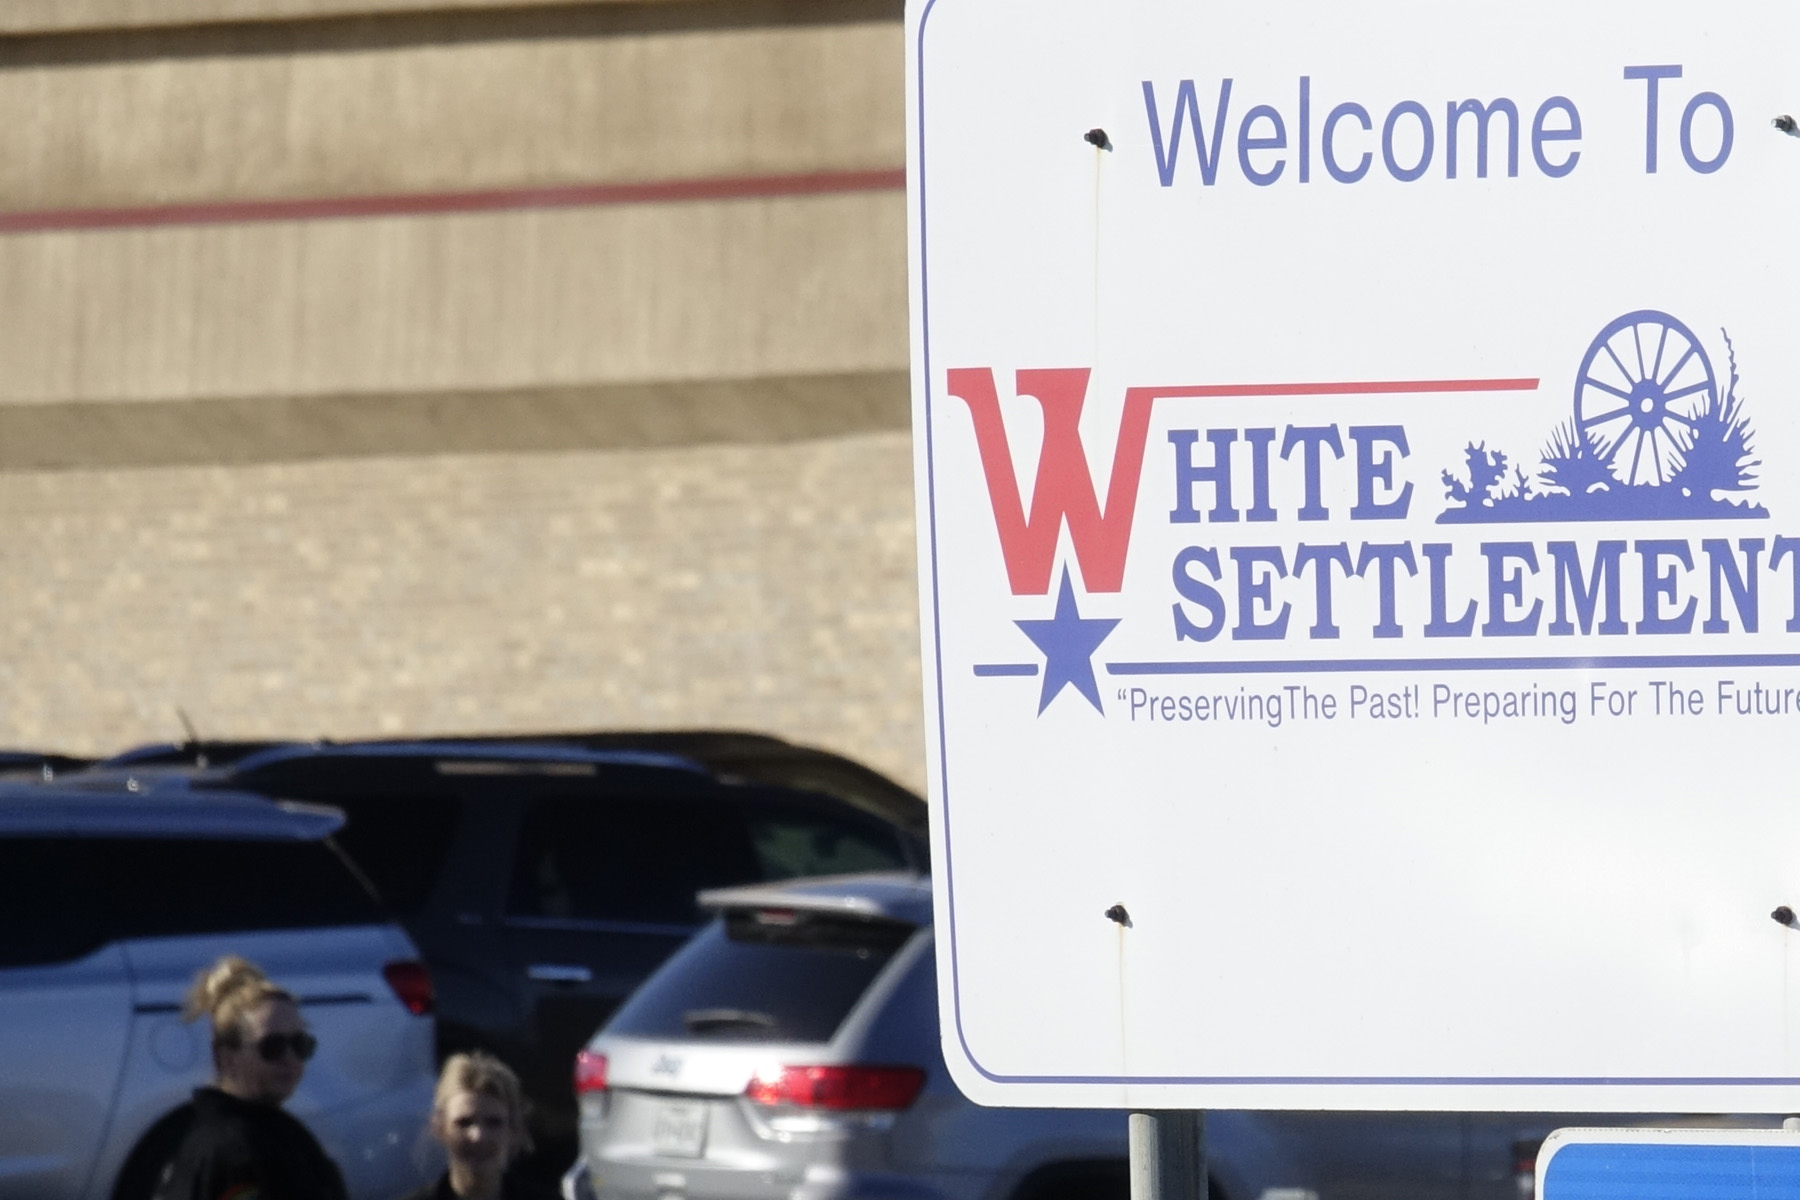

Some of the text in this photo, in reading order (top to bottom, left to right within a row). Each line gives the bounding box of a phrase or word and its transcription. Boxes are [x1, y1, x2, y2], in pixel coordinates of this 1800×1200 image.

[1142, 64, 1735, 188] Welcome To
[946, 367, 1413, 596] WHITE
[1350, 684, 1420, 719] Past!
[1433, 682, 1577, 725] Preparing
[1590, 681, 1638, 716] For
[1648, 680, 1704, 716] The
